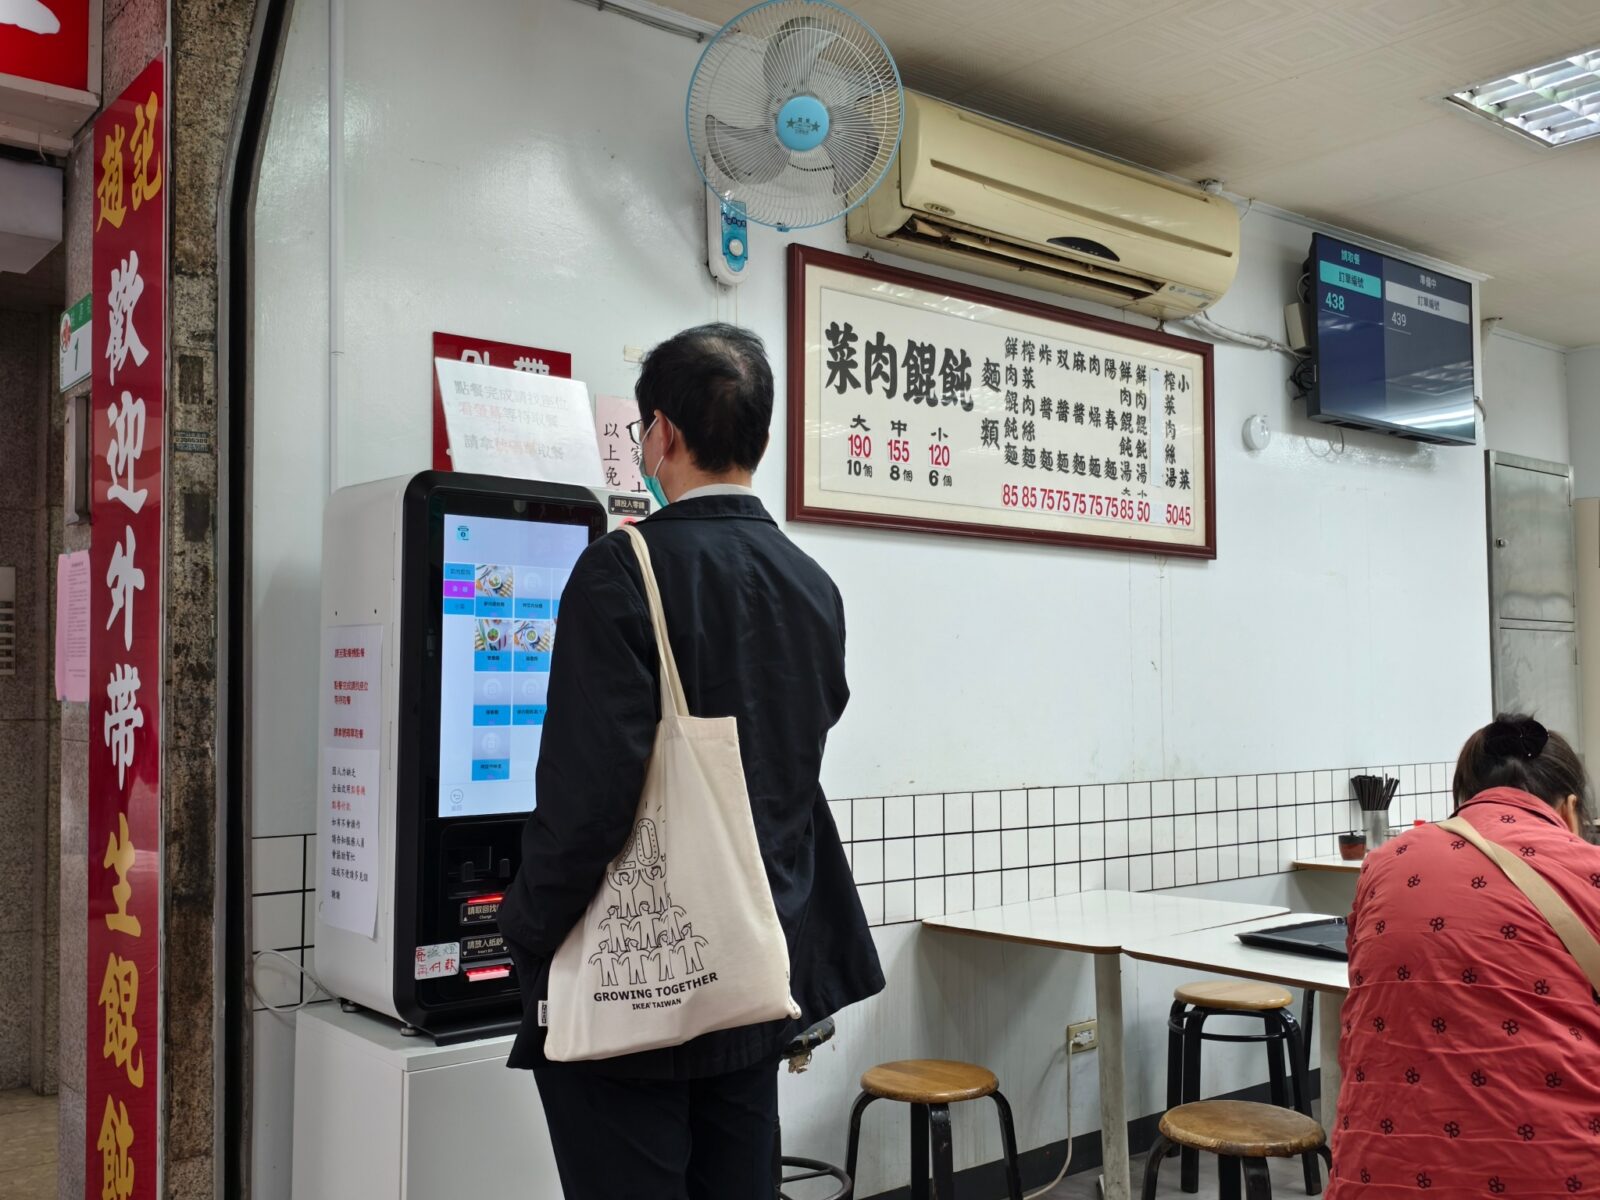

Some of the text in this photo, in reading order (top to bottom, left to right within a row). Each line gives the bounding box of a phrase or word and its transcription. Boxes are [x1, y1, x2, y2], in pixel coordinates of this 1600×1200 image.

[1325, 292, 1344, 311] 438
[1392, 312, 1406, 327] 439
[825, 321, 974, 411] 菜肉餛飩
[981, 357, 1001, 450] 麵類
[1004, 336, 1019, 465] 鮮肉餛飩麵
[1020, 340, 1036, 469] 榨菜肉絲麵
[850, 414, 870, 432] 大
[1072, 351, 1086, 476] 麻醬麵
[1088, 354, 1102, 478] 肉燥麵
[1104, 358, 1118, 480] 陽春麵
[890, 420, 907, 438] 中
[931, 427, 948, 442] 小
[1178, 374, 1191, 490] 小菜
[848, 434, 872, 458] 190
[888, 440, 910, 462] 155
[929, 444, 950, 467] 120
[847, 460, 872, 478] 10個
[890, 465, 912, 482] 8個
[929, 470, 952, 487] 6個
[1002, 484, 1018, 506] 85
[1022, 486, 1037, 508] 85
[1040, 488, 1054, 510] 75
[1056, 489, 1070, 512] 75
[1072, 491, 1086, 514] 75
[1089, 493, 1102, 516] 75
[1105, 496, 1118, 518] 75
[1120, 499, 1134, 520] 85
[1137, 501, 1150, 522] 50
[1166, 504, 1178, 524] 50
[1178, 506, 1191, 526] 45
[468, 904, 499, 915] 請取回找
[594, 972, 719, 1002] GROWING TOGETHER
[652, 998, 682, 1008] TAIWAN
